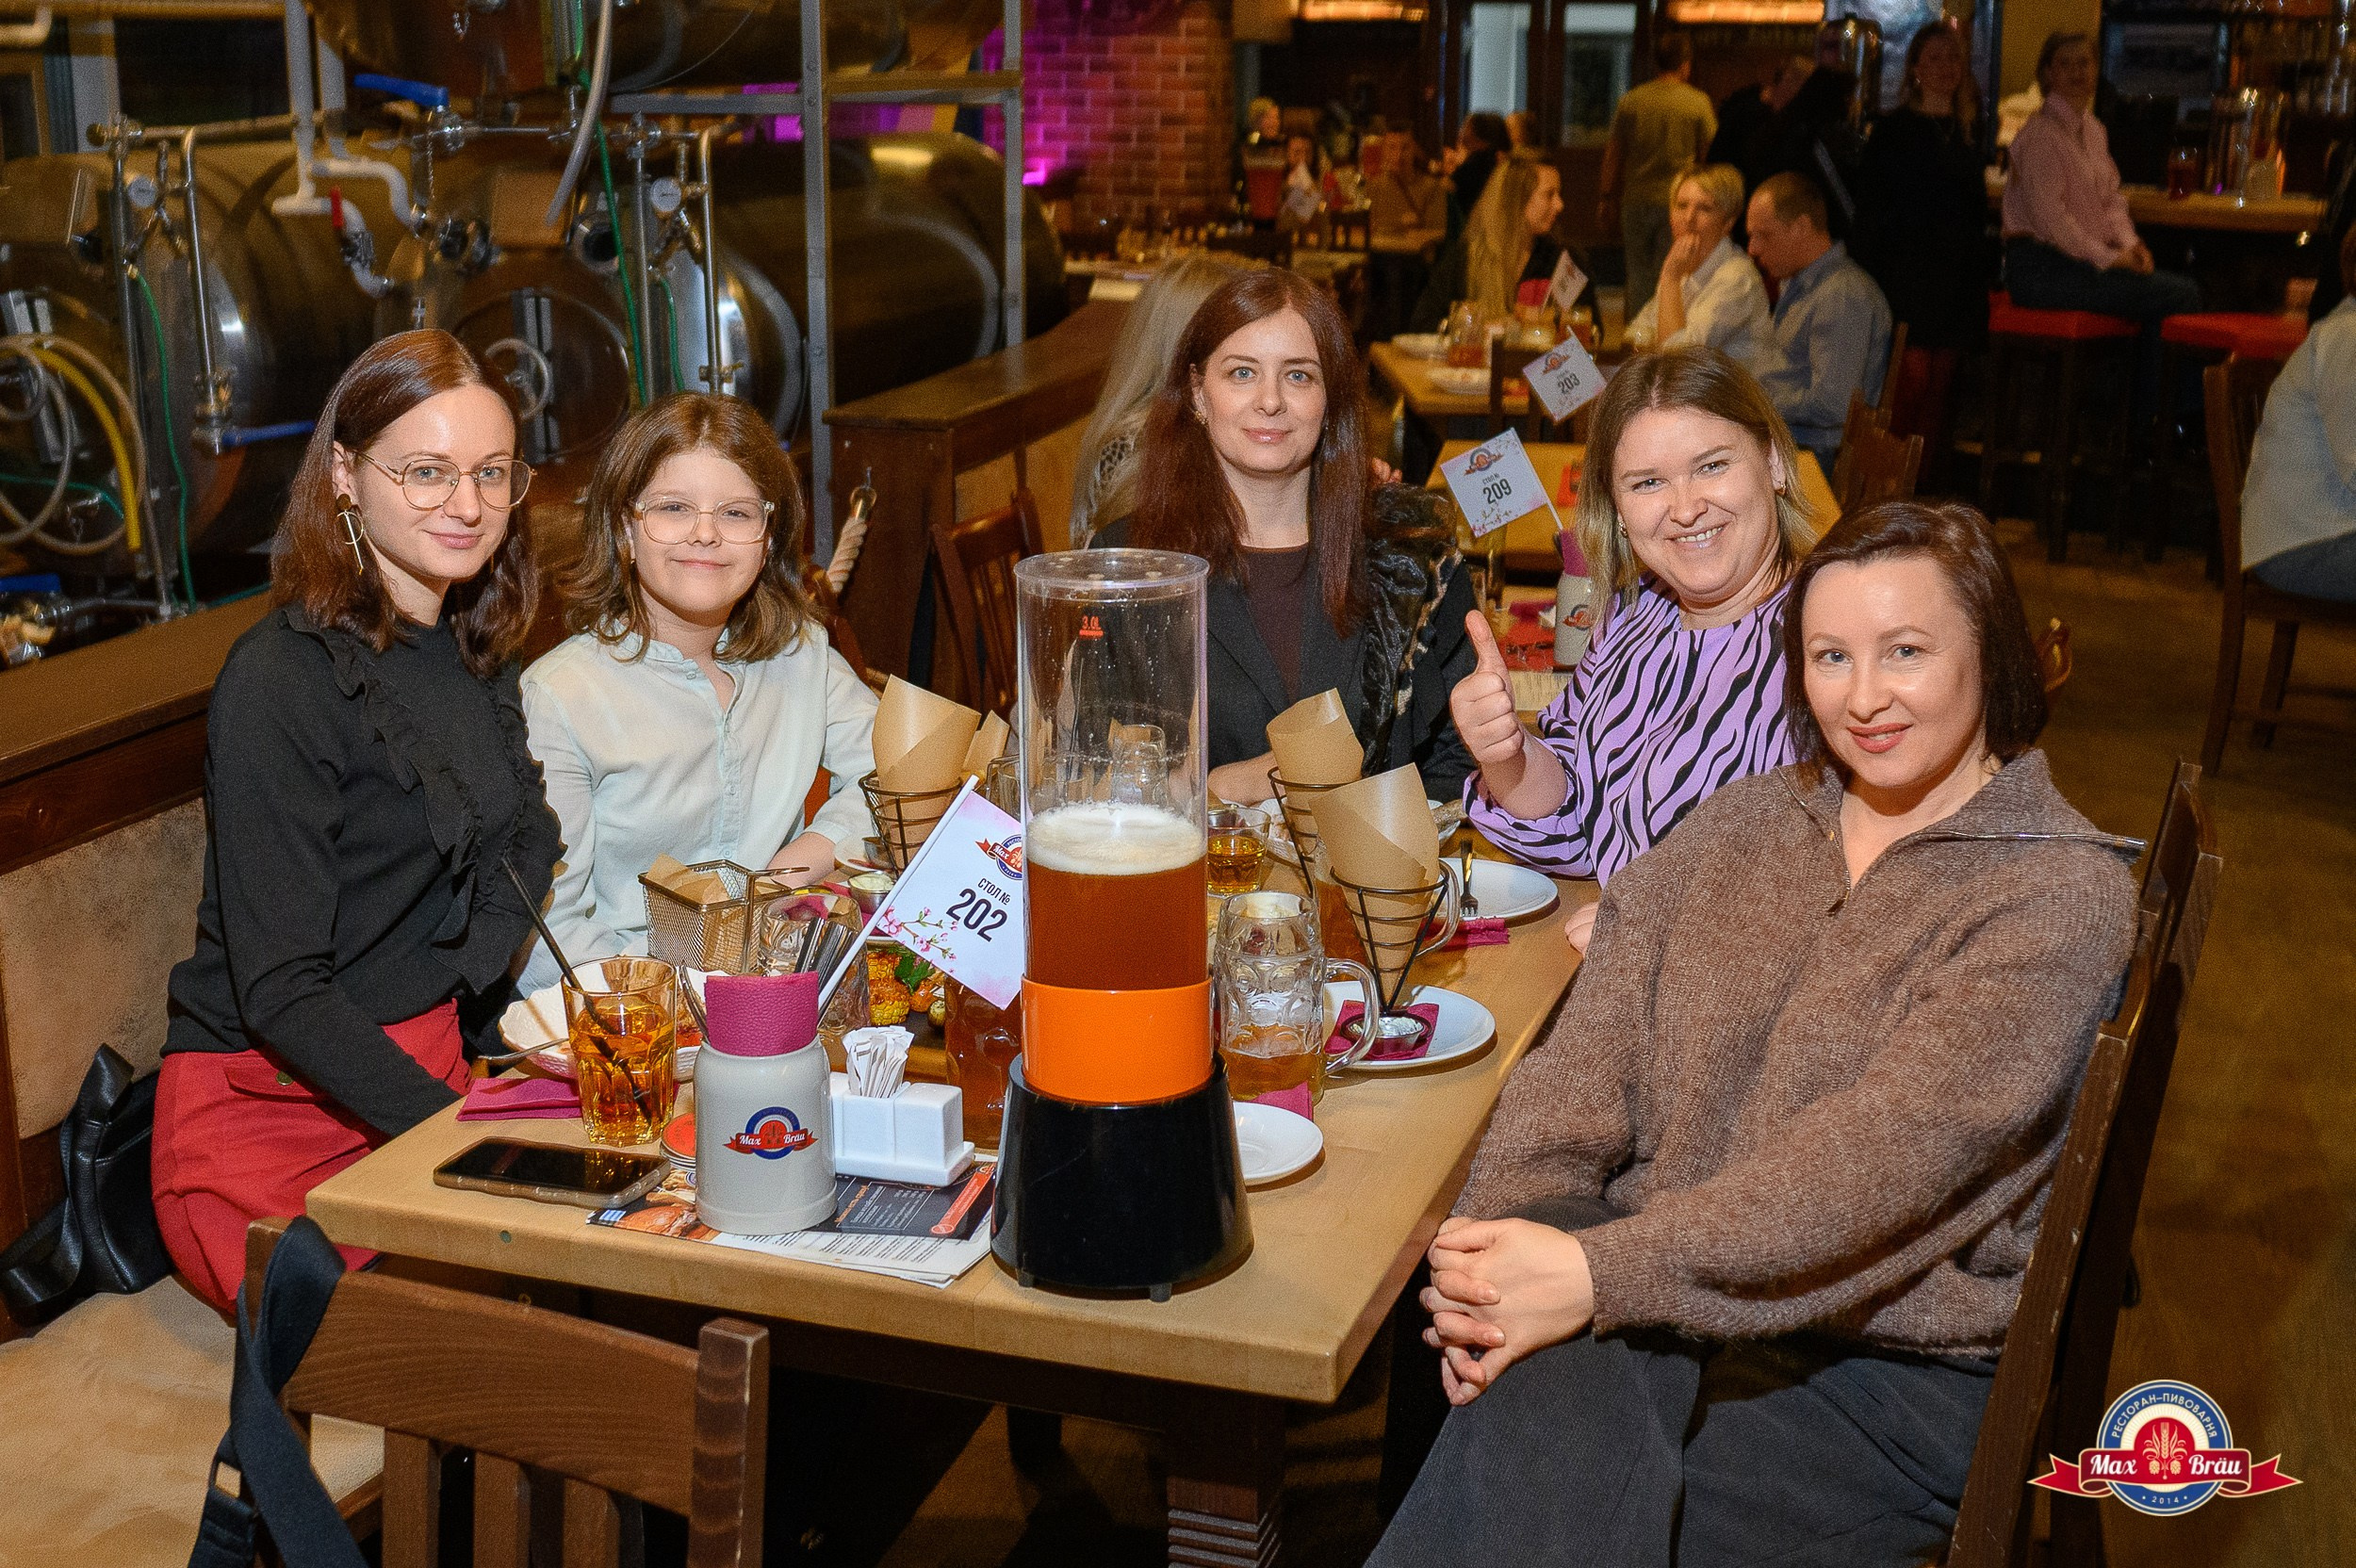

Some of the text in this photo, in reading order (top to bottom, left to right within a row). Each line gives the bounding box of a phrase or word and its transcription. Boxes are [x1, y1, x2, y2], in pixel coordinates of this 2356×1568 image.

[1558, 372, 1580, 394] 203
[1482, 478, 1512, 505] 209
[993, 844, 1010, 859] Max
[977, 877, 1011, 906] СТОЛ №
[945, 888, 1008, 942] 202
[739, 1135, 761, 1145] Max
